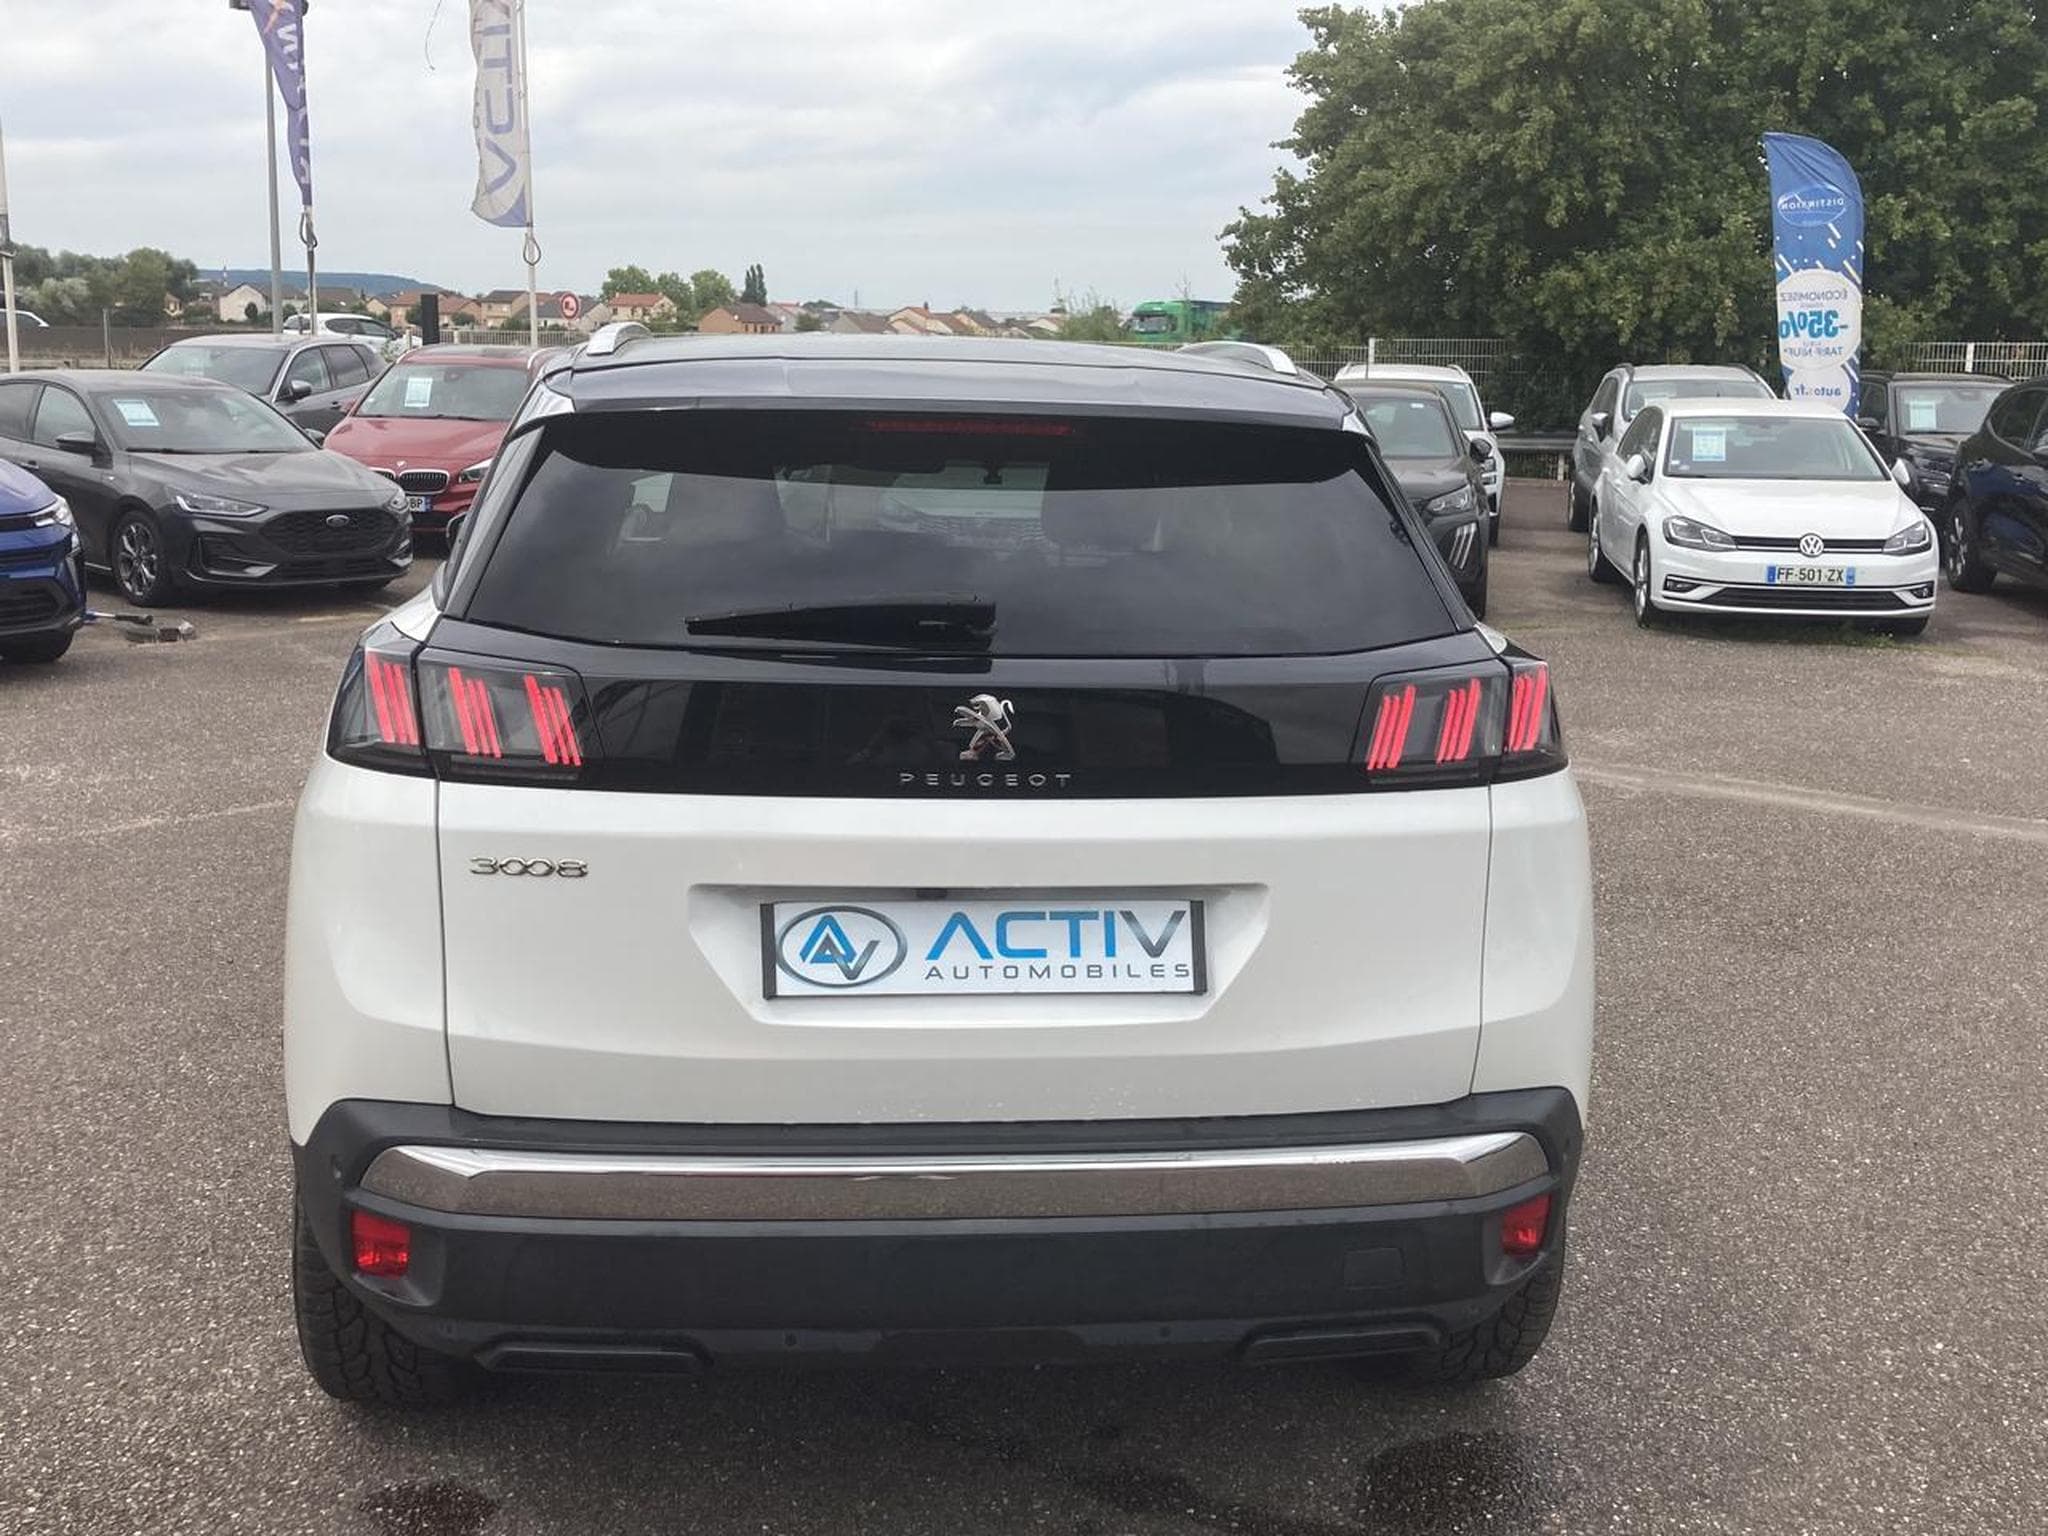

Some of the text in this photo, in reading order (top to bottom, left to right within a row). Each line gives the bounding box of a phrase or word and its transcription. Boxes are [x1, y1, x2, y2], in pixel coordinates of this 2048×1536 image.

[900, 772, 1072, 787] PEUGEOT
[470, 856, 589, 878] 3008
[925, 910, 1187, 960] ACTIV
[925, 963, 1190, 980] AUTOMOBILES
